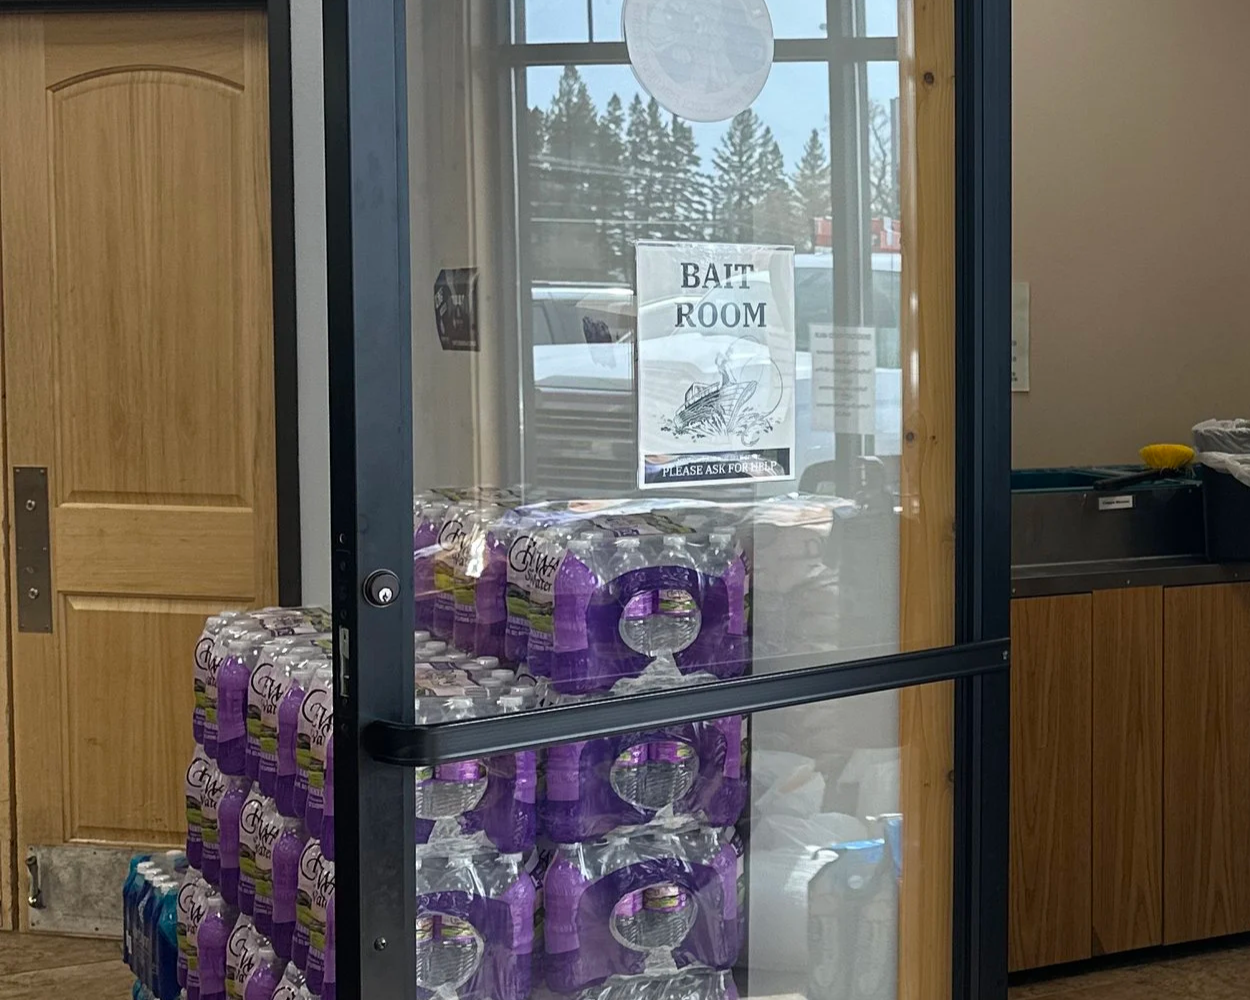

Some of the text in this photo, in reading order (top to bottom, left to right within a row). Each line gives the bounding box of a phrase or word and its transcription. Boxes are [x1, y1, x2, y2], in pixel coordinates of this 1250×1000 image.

[680, 262, 754, 289] BAIT
[674, 302, 767, 328] ROOM
[662, 466, 703, 477] PLEASE
[705, 464, 725, 474] ASK
[728, 462, 749, 473] FOR
